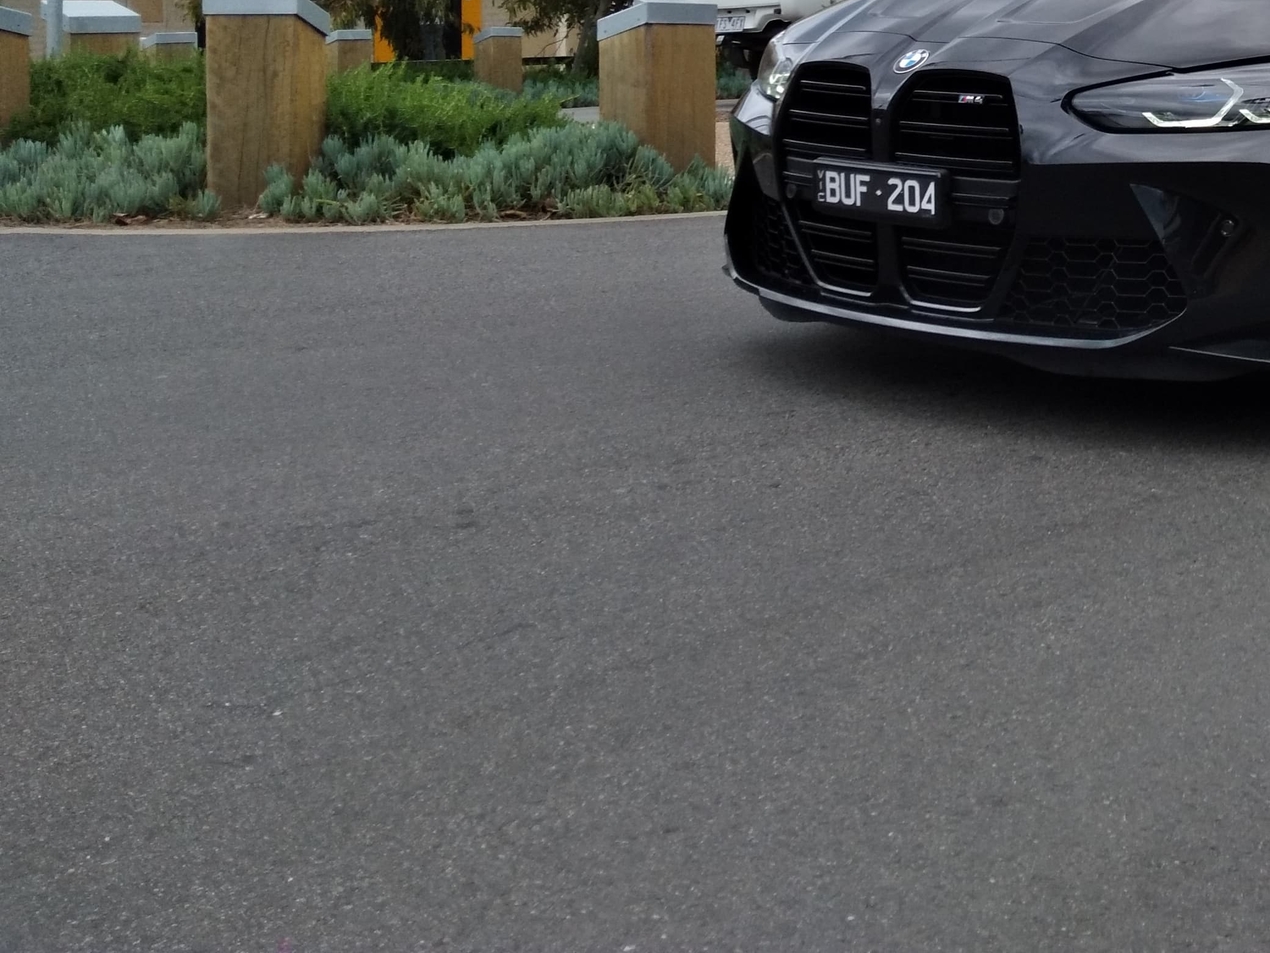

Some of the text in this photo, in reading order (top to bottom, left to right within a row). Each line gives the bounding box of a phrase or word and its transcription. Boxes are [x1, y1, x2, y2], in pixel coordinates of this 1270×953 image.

[817, 169, 825, 202] VIC
[825, 170, 936, 216] BUF 204
